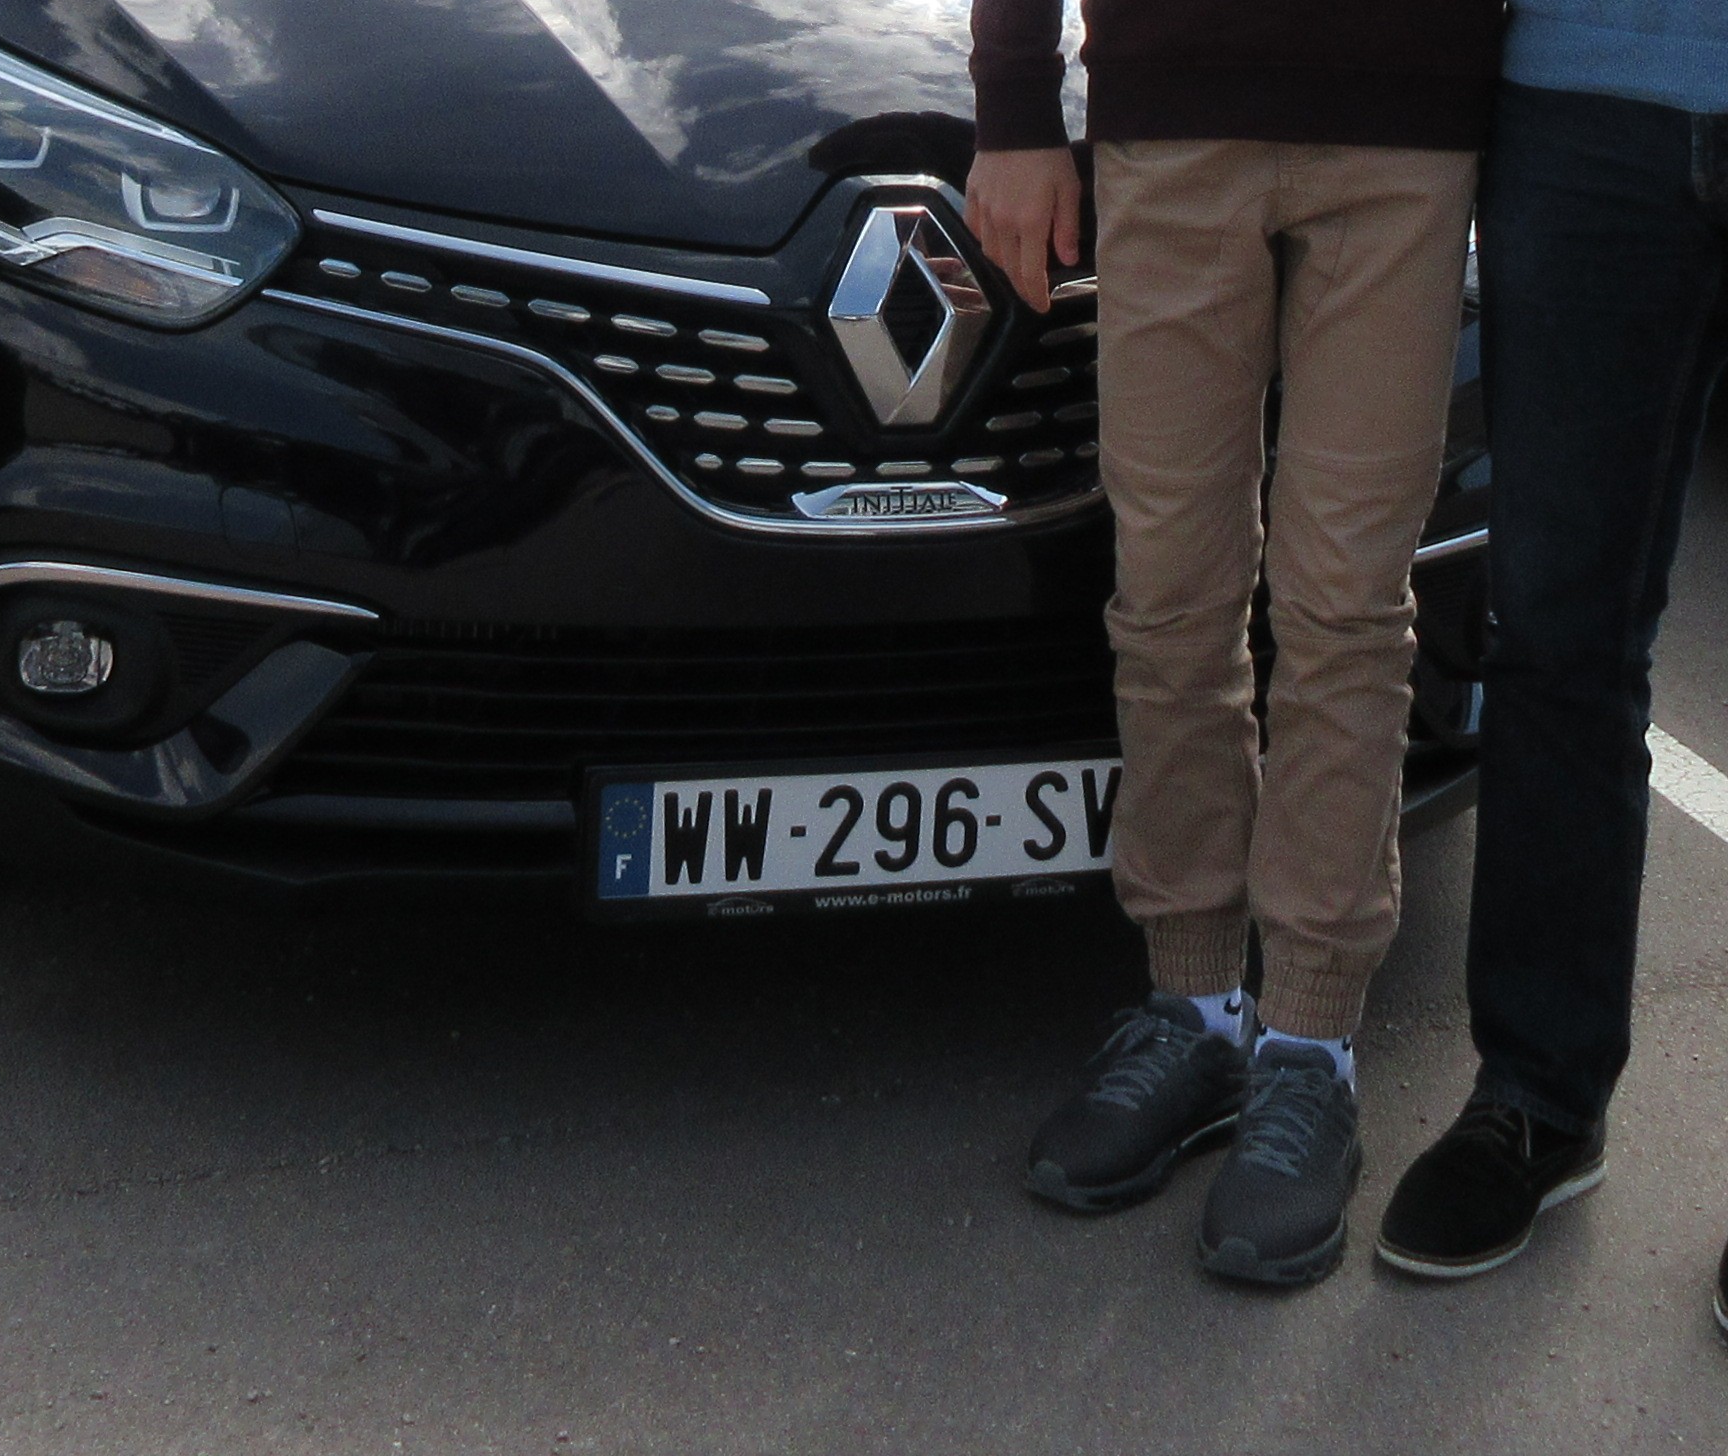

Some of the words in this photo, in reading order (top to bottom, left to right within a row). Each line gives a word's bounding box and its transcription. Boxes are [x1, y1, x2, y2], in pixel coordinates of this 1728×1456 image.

[663, 766, 1122, 885] WW-296-SV
[615, 855, 633, 880] F
[814, 885, 973, 909] www.e-motors.fr
